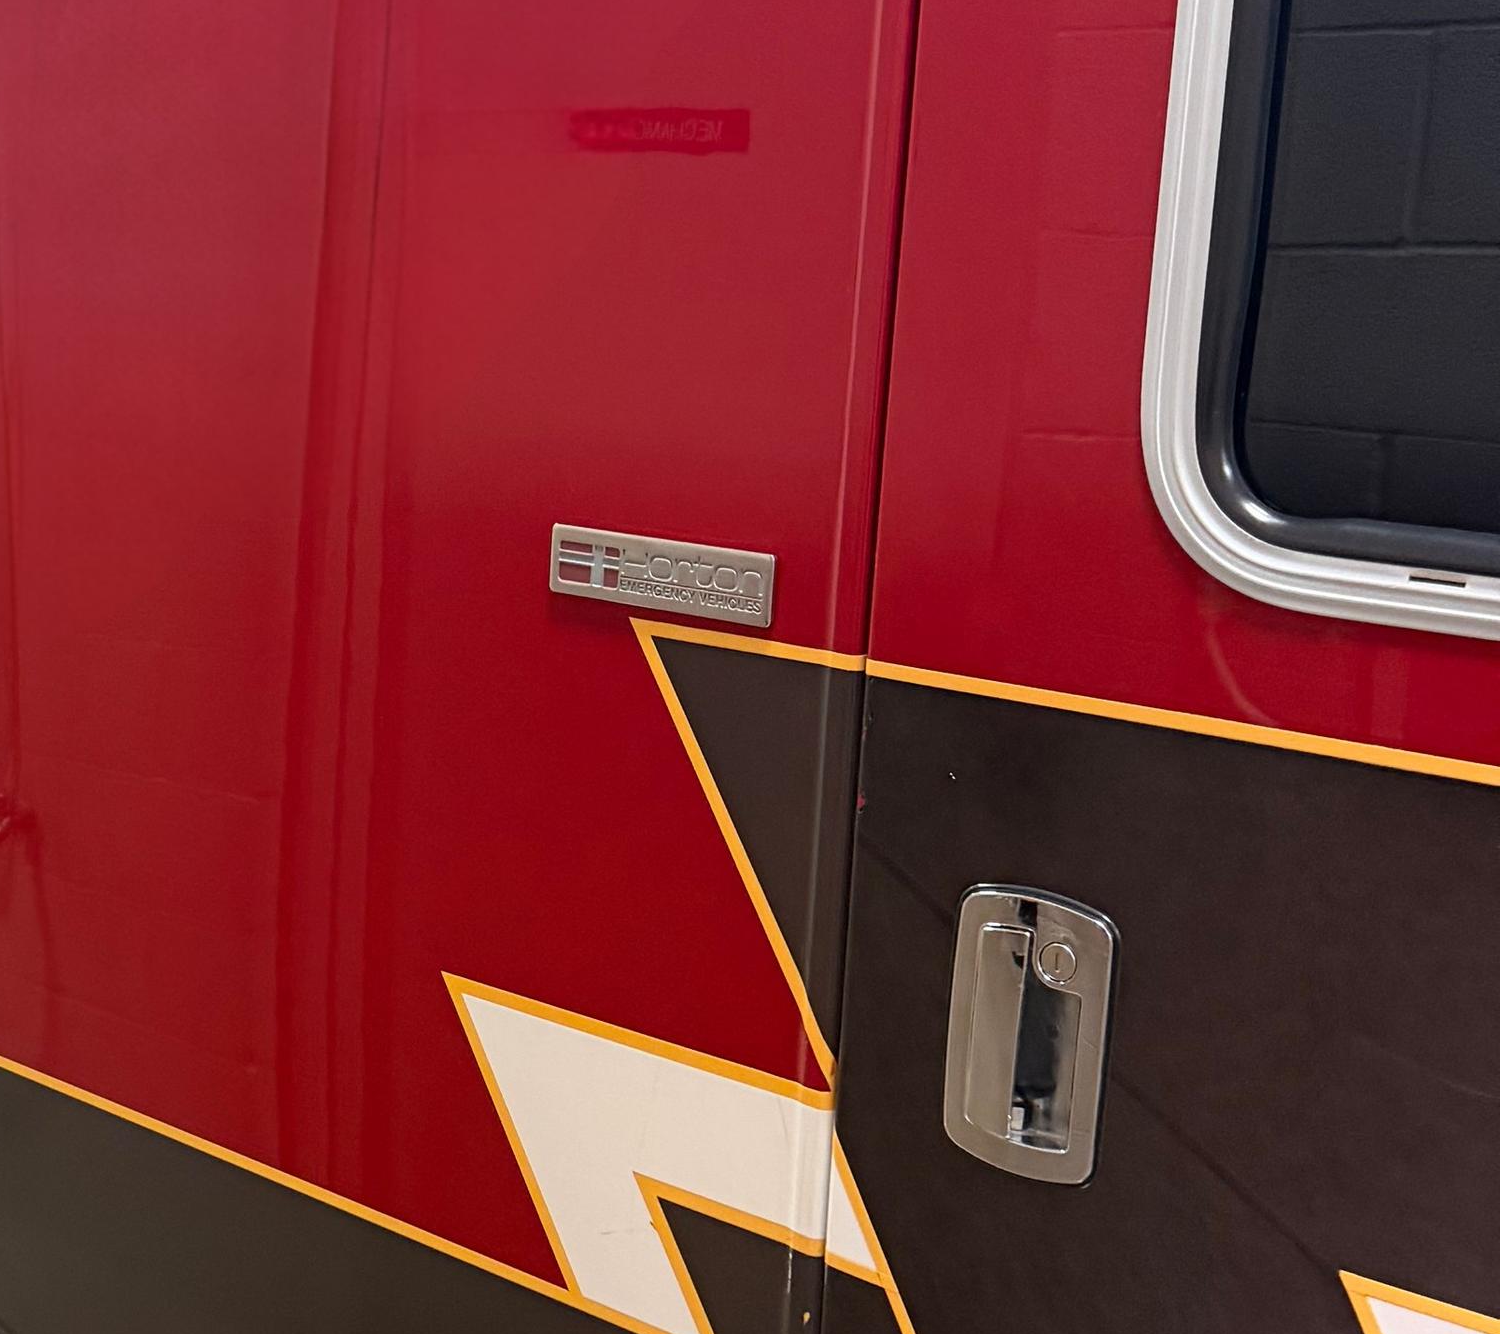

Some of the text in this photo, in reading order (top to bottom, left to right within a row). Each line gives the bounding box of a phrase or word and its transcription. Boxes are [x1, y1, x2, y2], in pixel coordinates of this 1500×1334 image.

[620, 547, 764, 597] Horton
[619, 579, 763, 615] EMERGENCY VEHICLES
